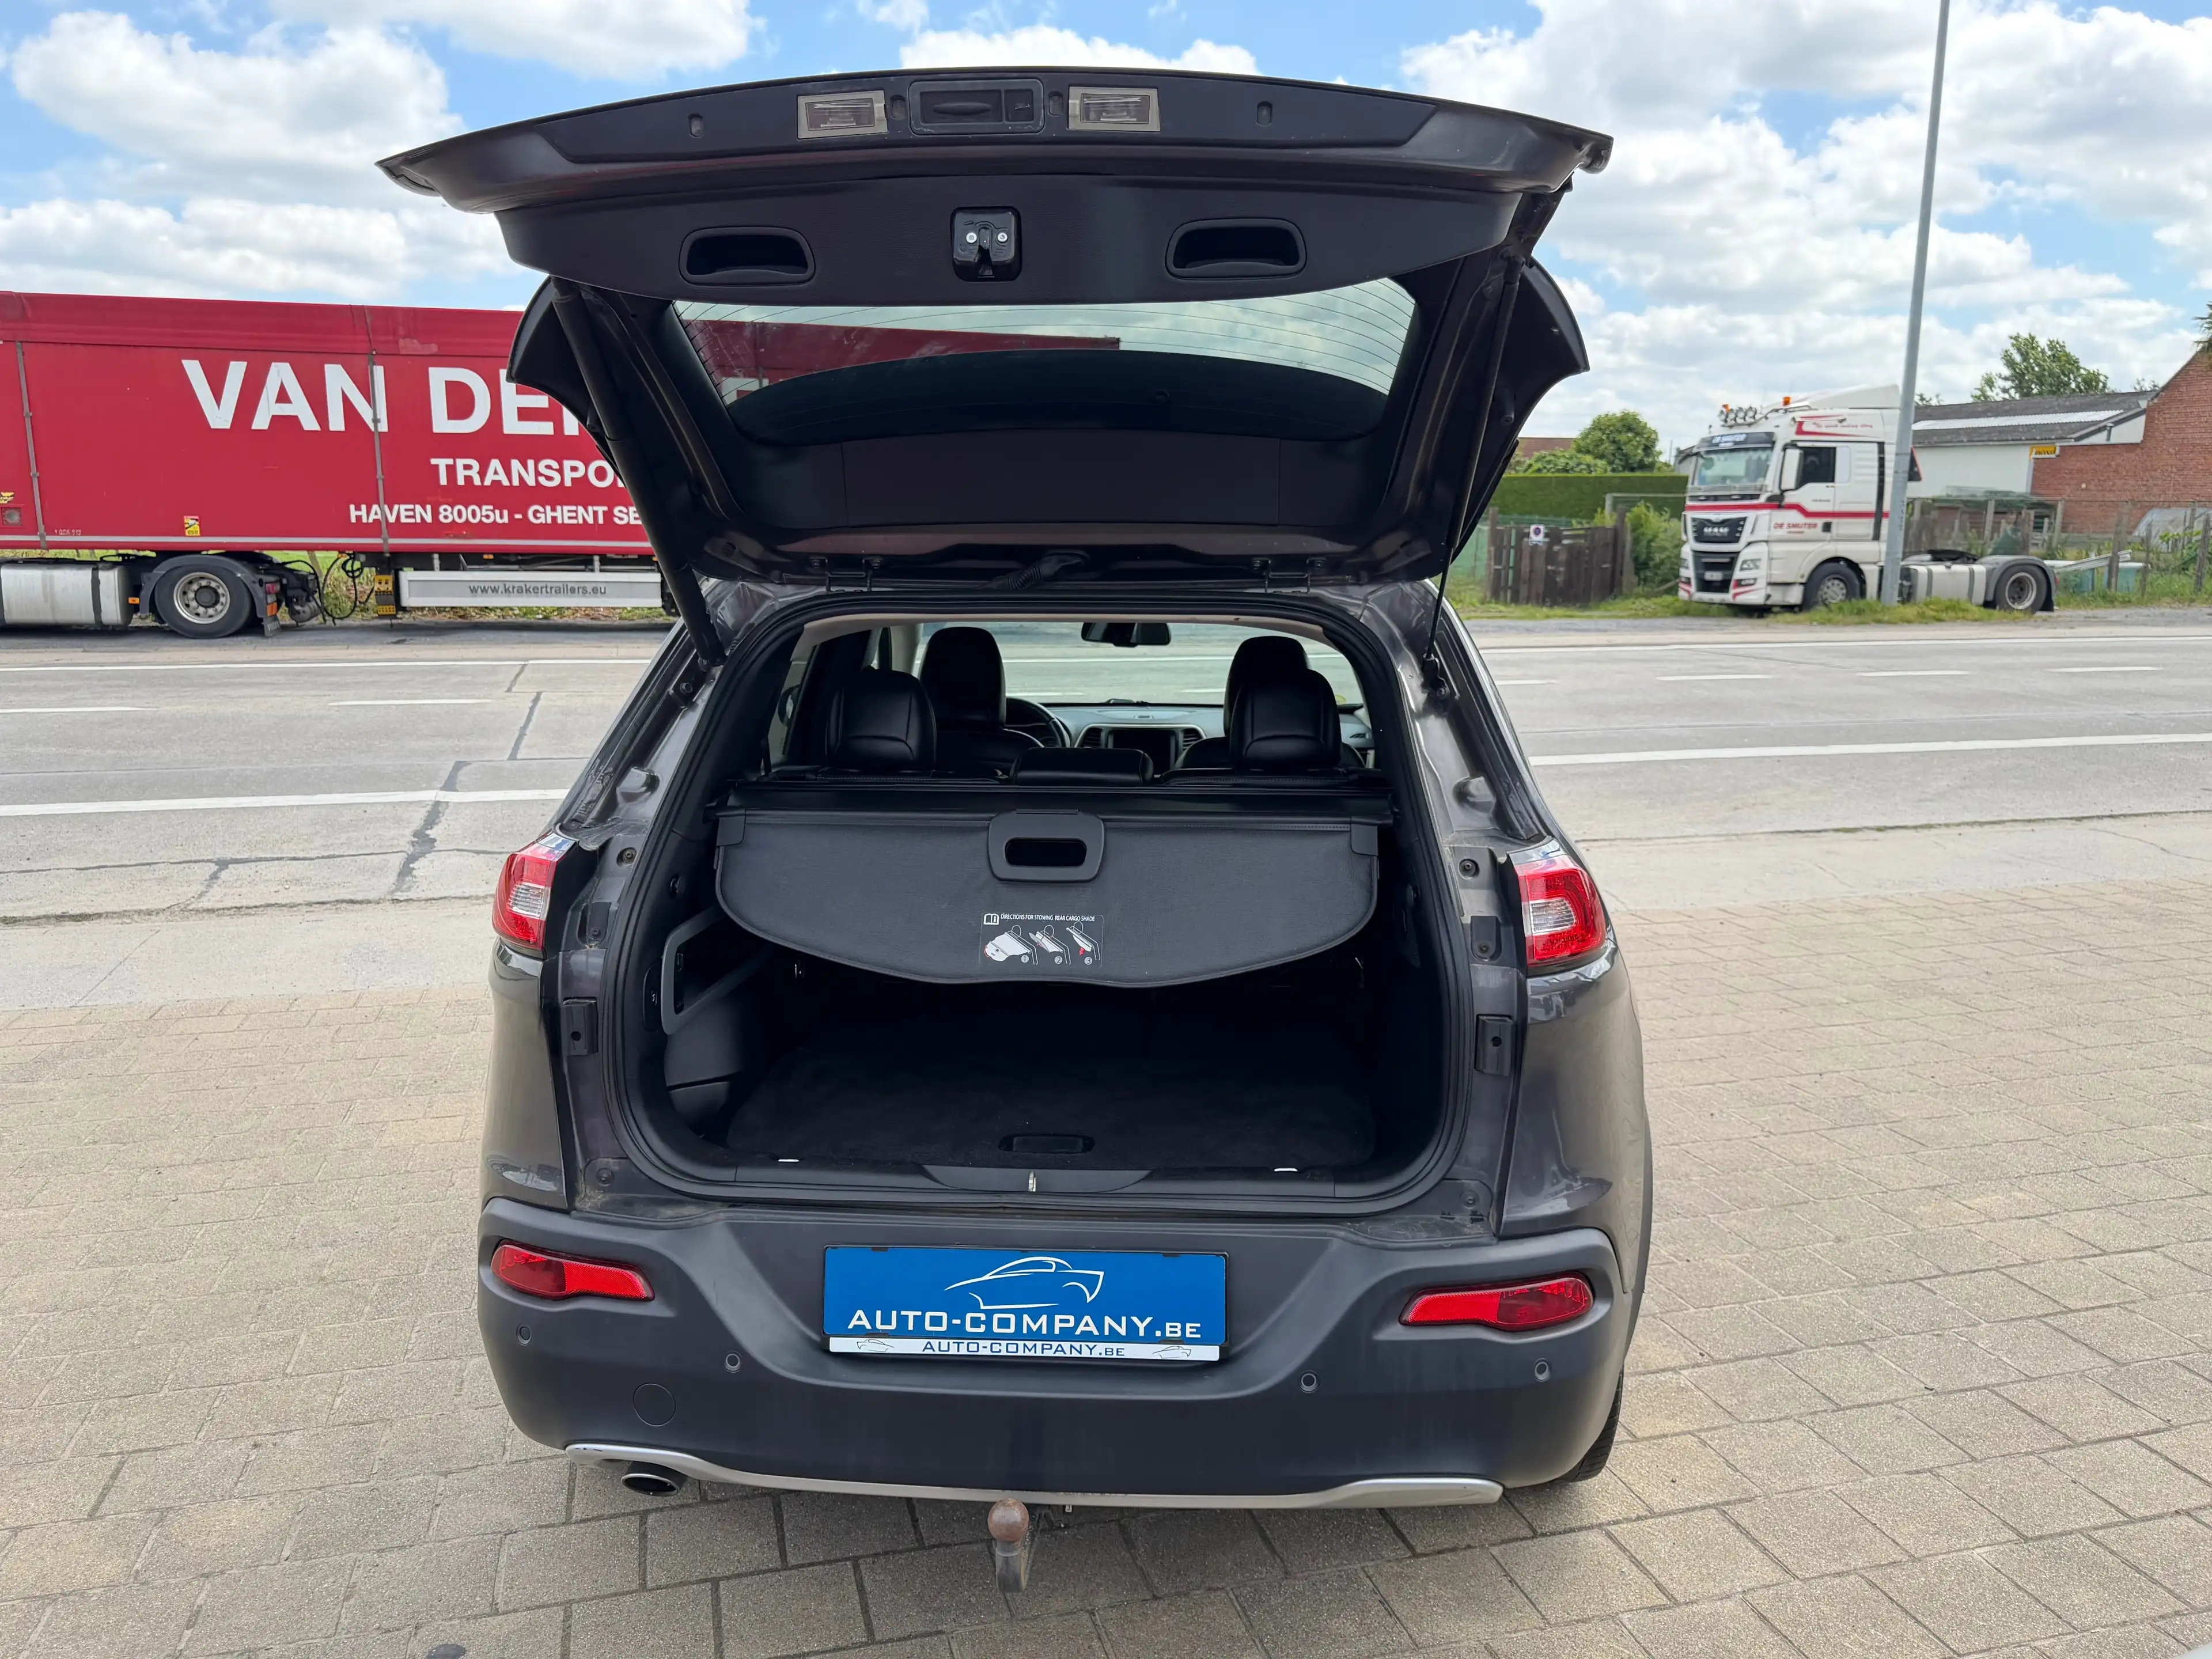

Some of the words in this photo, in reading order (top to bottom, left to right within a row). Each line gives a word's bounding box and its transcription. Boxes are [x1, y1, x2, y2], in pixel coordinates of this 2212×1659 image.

[181, 359, 389, 433] VAN
[428, 366, 582, 436] DE
[430, 458, 626, 488] TRANSPO
[349, 504, 433, 524] HAVEN
[438, 505, 509, 524] 8005u
[528, 505, 608, 525] GHENT
[468, 584, 607, 595] www.krakertrailers.eu
[847, 1309, 1202, 1339] AUTO-COMPANY.BE
[922, 1341, 1126, 1357] AUTO-COMPANY.BE
